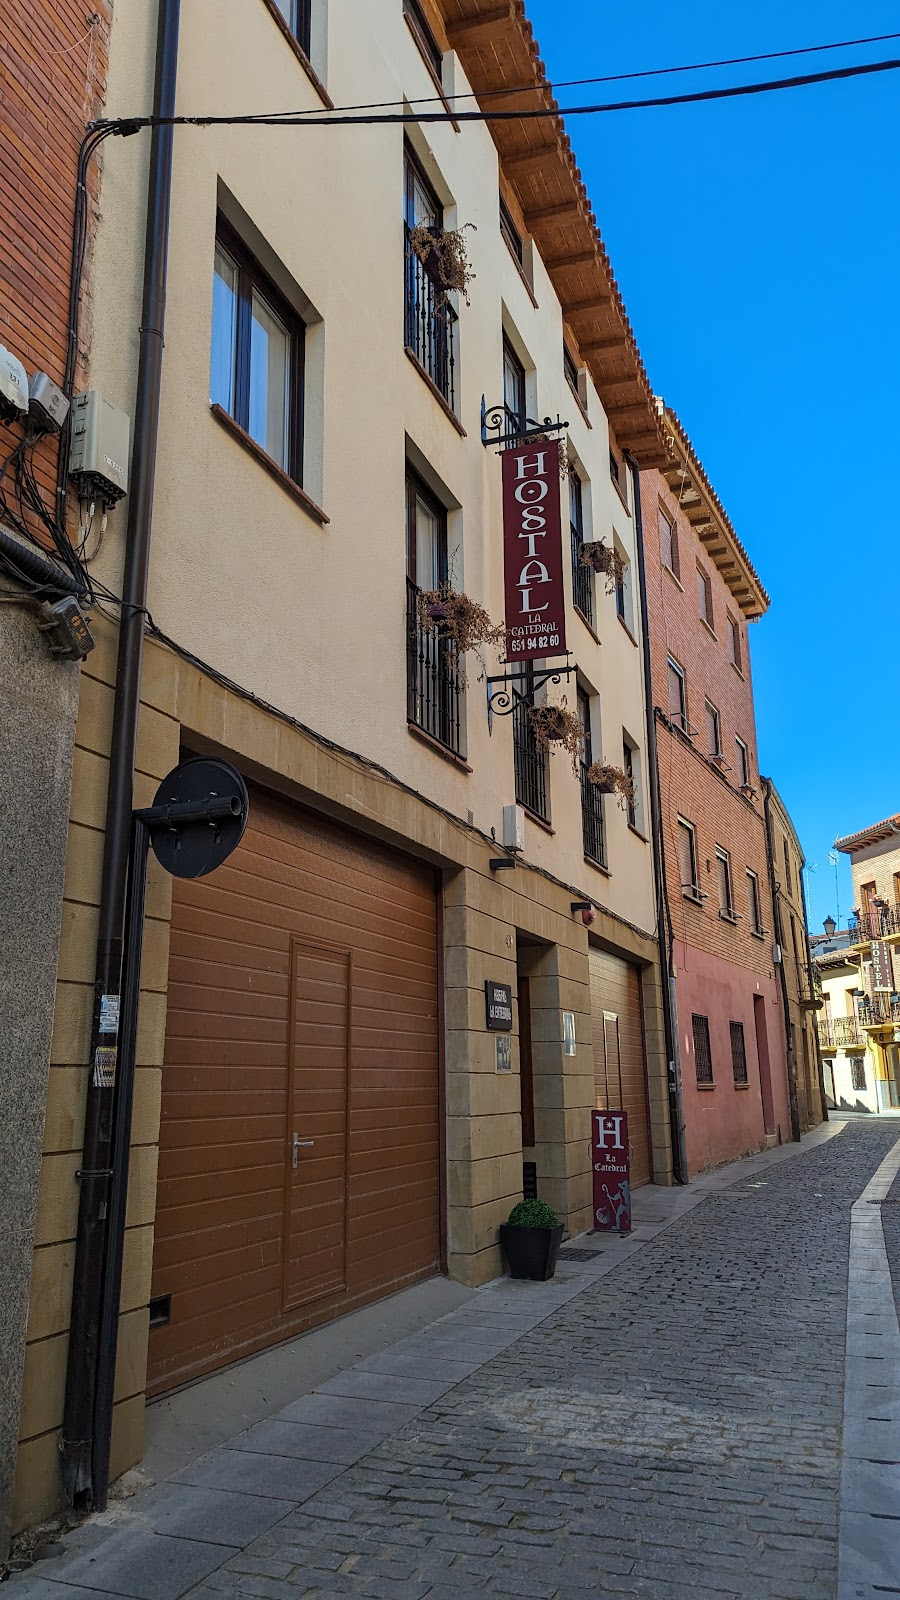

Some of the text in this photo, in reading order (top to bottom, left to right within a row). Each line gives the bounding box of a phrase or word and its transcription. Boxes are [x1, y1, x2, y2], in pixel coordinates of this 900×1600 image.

[513, 451, 553, 614] HOSTAL
[528, 613, 542, 624] LA
[511, 621, 560, 637] CATEDRAL
[511, 633, 560, 652] 651 94 82 60
[595, 1115, 625, 1149] H
[604, 1153, 616, 1163] La
[594, 1162, 627, 1173] Catedral
